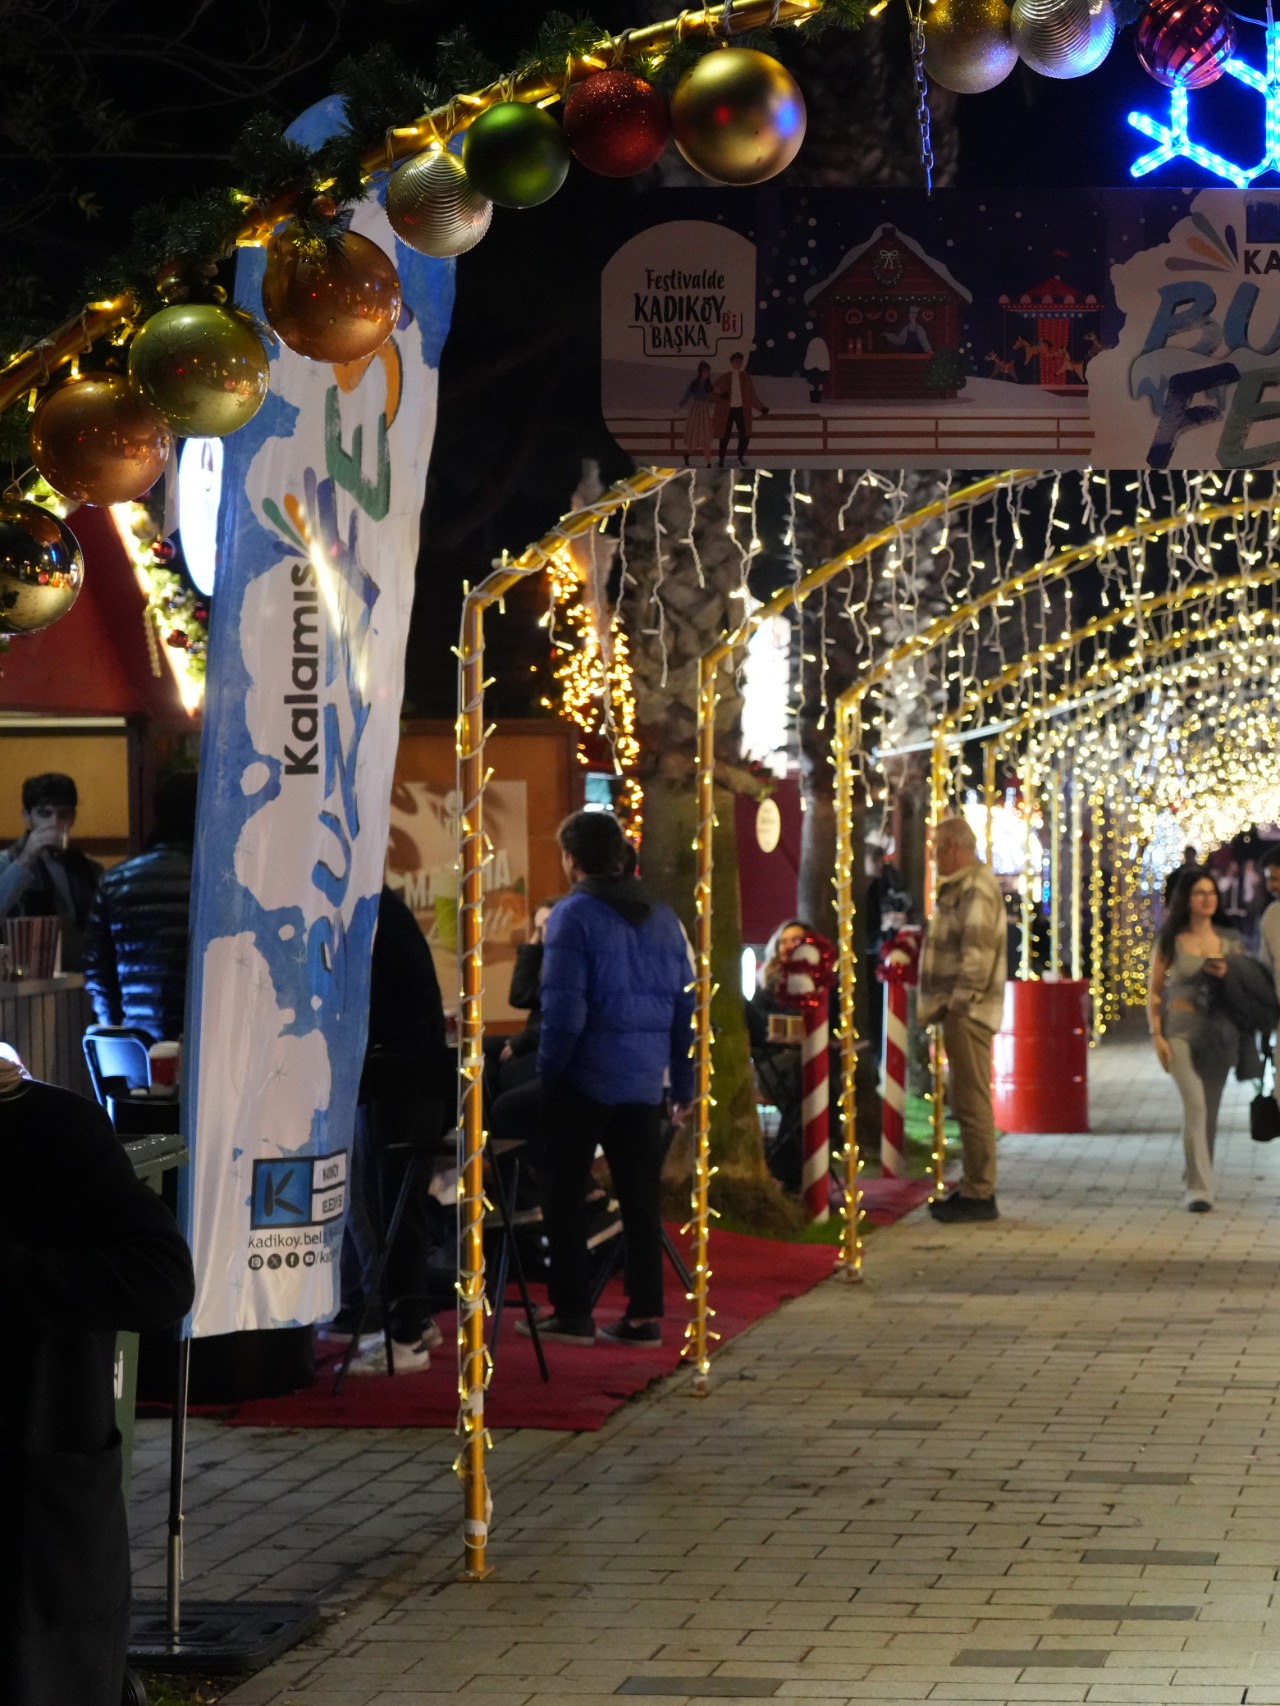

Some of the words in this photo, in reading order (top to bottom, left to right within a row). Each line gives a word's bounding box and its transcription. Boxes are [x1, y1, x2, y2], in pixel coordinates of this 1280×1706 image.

[645, 268, 725, 291] Festivalde
[634, 293, 726, 325] KADIKÖY
[650, 325, 711, 353] BAŞKA
